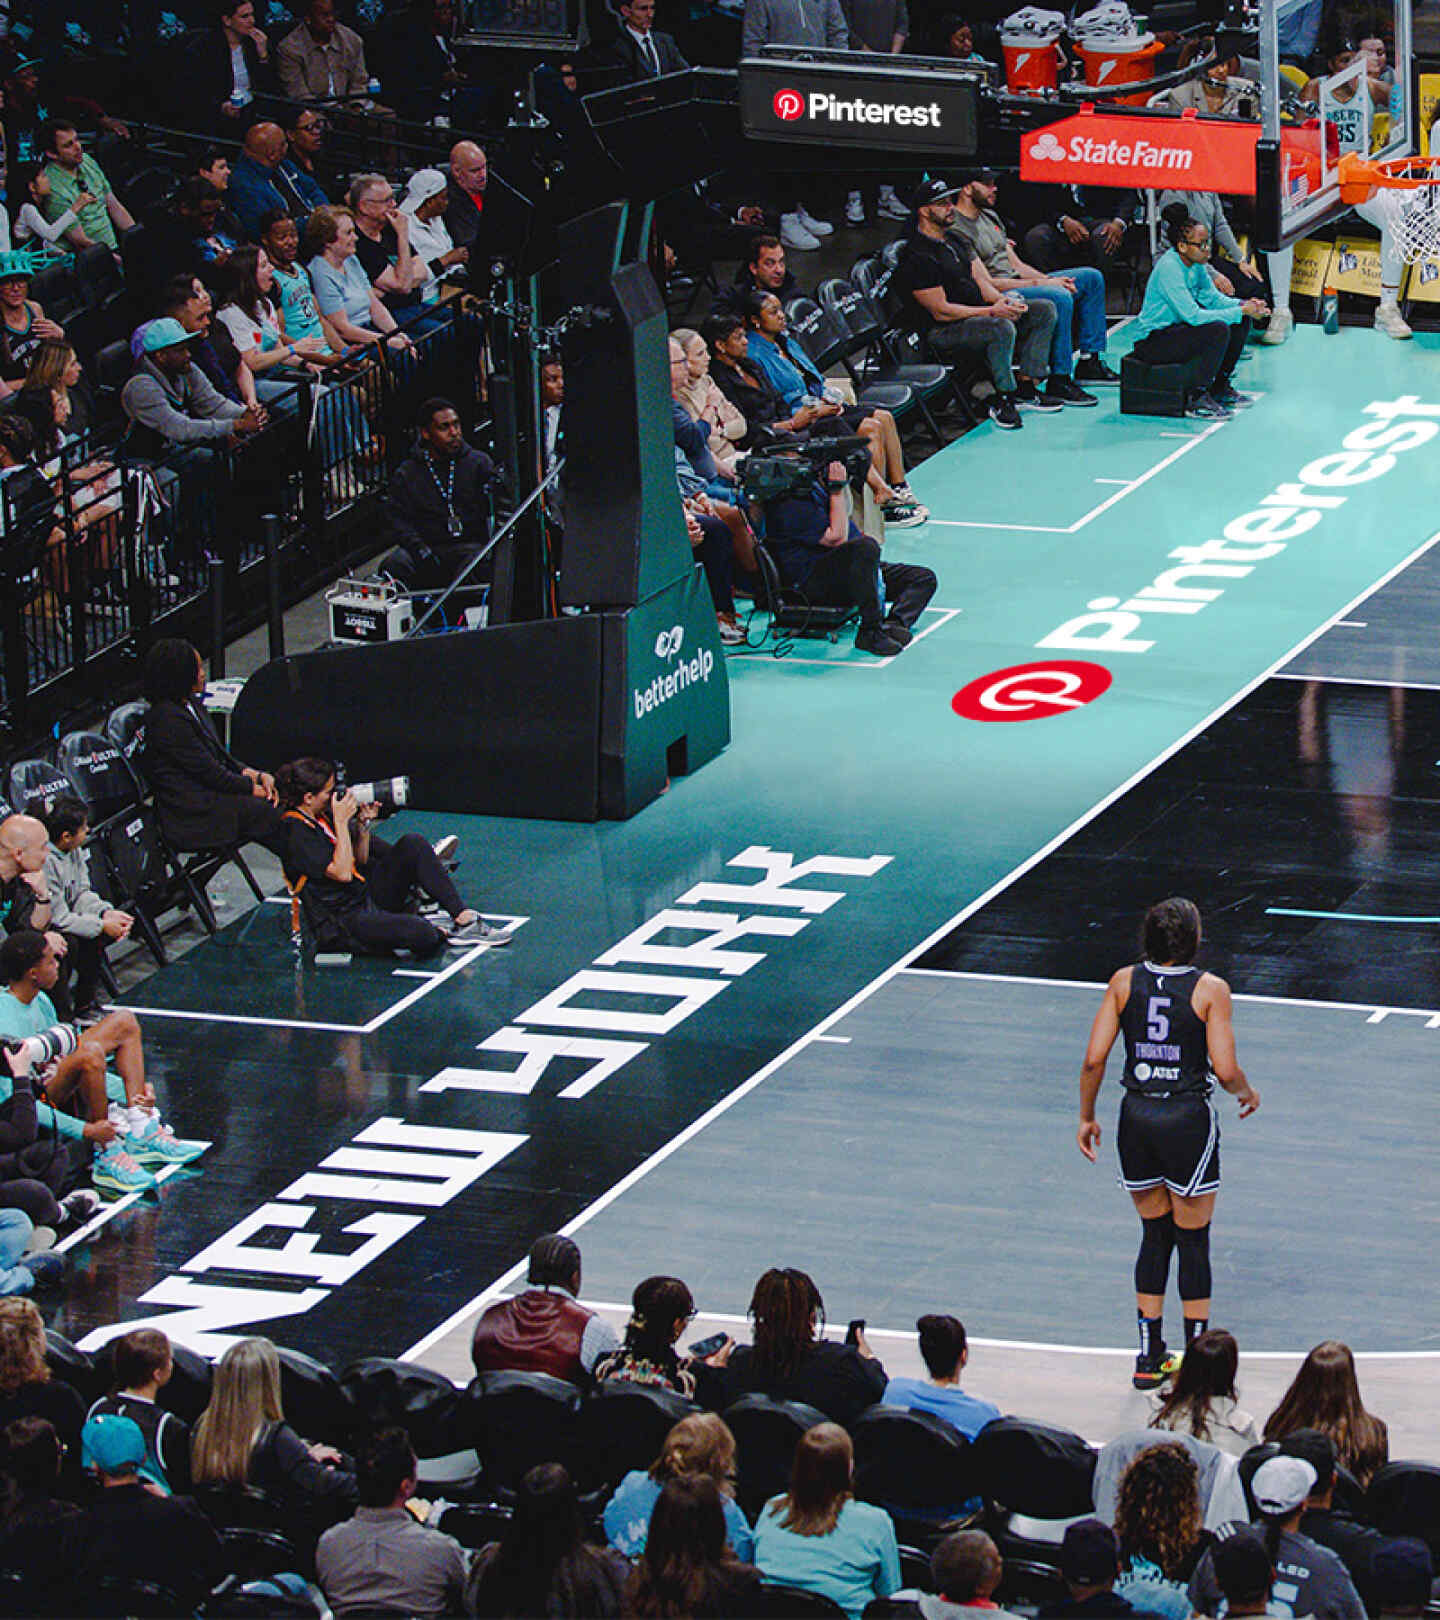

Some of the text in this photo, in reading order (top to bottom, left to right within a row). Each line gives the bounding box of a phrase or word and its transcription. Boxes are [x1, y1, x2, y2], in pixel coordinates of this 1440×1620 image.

[808, 92, 942, 127] Pinterest
[634, 647, 714, 719] betterhelp
[1147, 996, 1171, 1042] 5
[1151, 1066, 1180, 1080] AT&T
[75, 845, 896, 1362] NEW YORK
